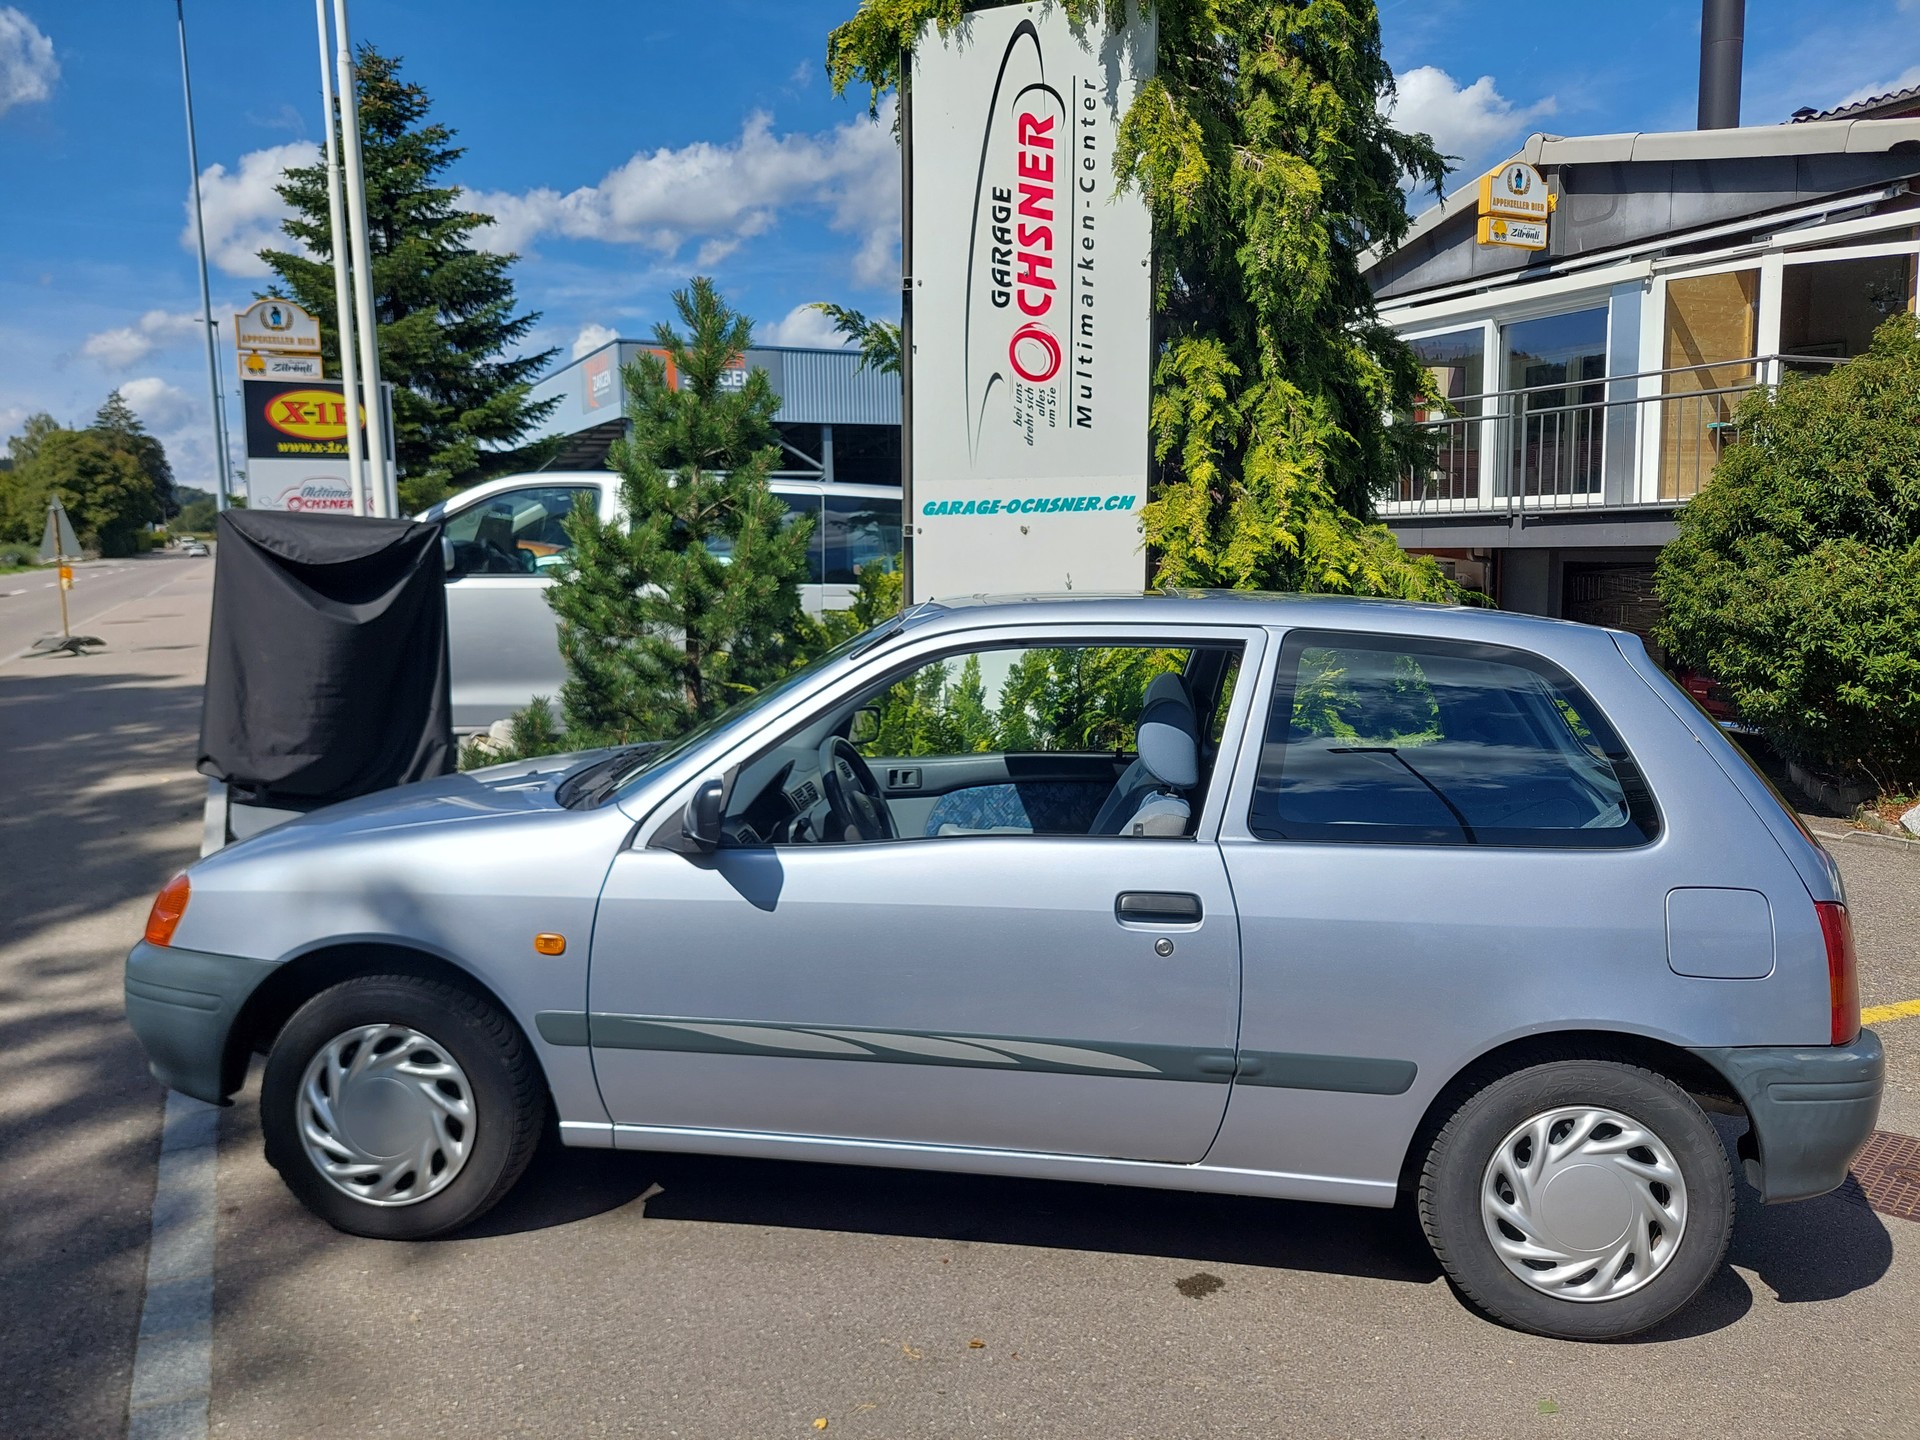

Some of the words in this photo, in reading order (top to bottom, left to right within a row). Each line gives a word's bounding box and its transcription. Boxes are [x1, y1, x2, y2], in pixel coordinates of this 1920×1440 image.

[1493, 198, 1529, 210] APPENZELLER
[1531, 202, 1544, 212] BIER
[991, 187, 1013, 308] GARAGE
[1009, 113, 1061, 382] OCHSNER
[1076, 79, 1097, 428] Multimarken-Center
[1024, 387, 1034, 411] sich
[1035, 388, 1045, 417] alles
[1046, 387, 1056, 407] Sie
[1012, 406, 1022, 427] bei
[1049, 409, 1056, 428] um
[1023, 413, 1034, 446] dreht
[922, 495, 1137, 516] GARAGE-OCHSNER.CH
